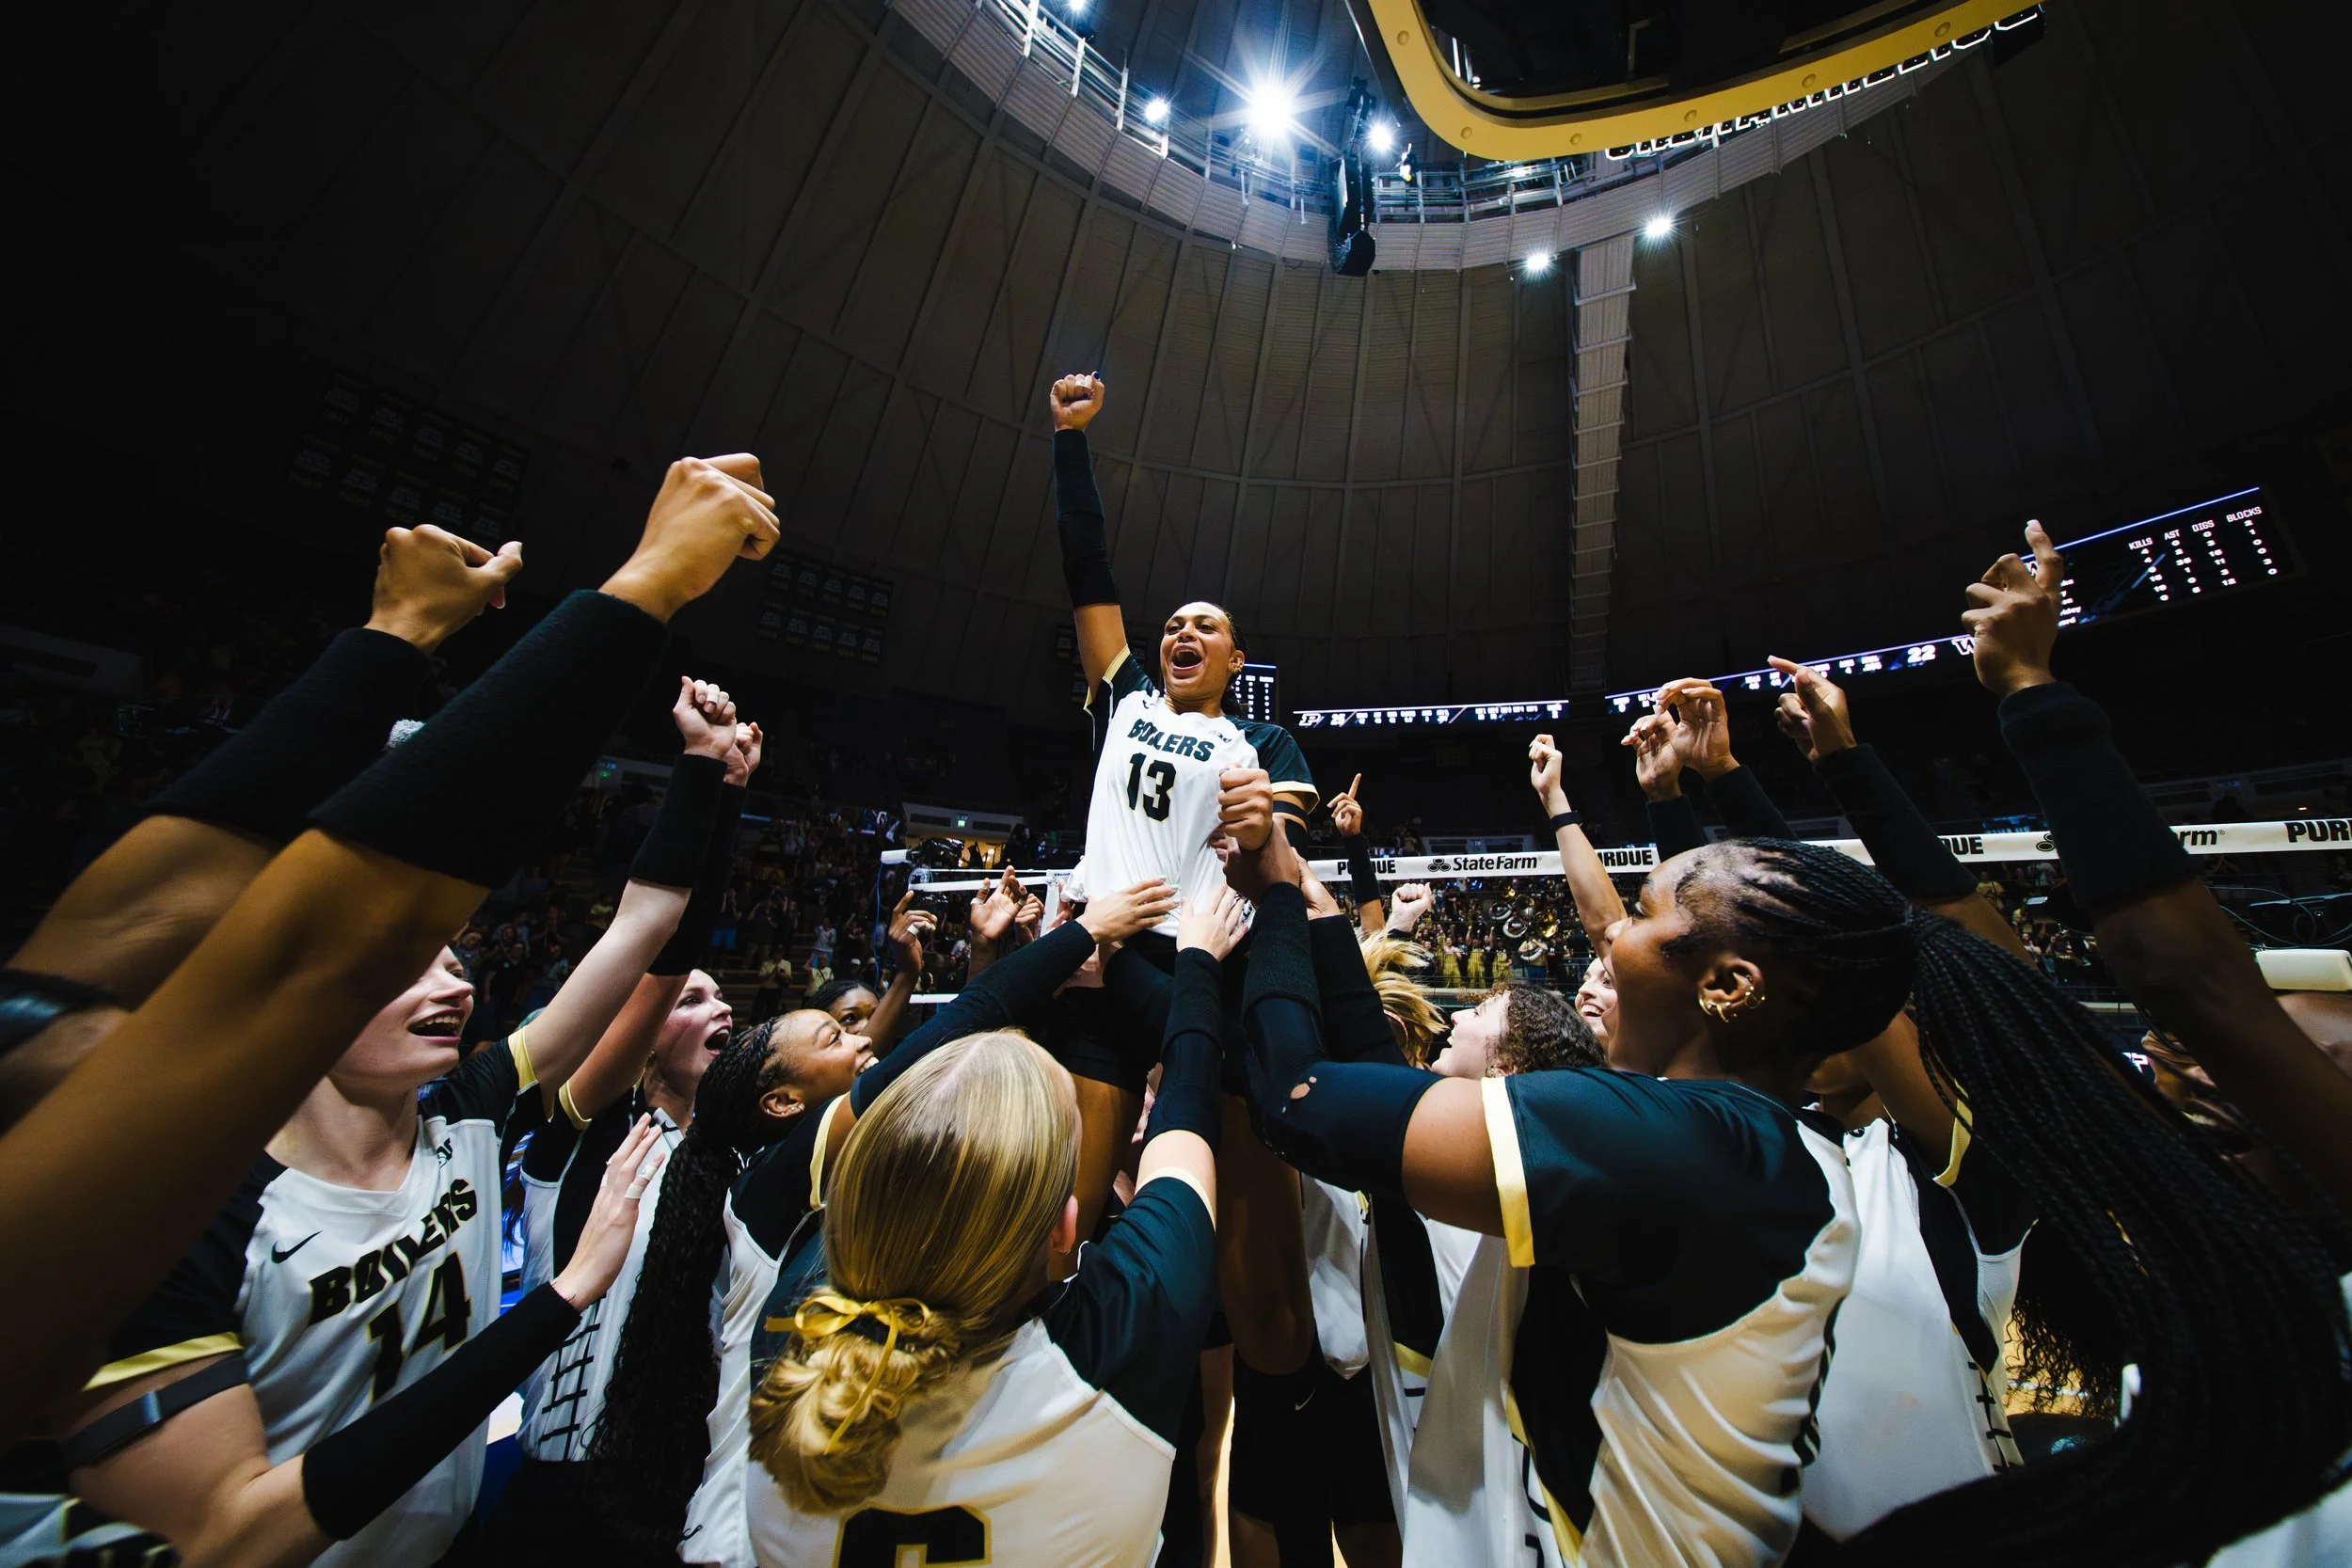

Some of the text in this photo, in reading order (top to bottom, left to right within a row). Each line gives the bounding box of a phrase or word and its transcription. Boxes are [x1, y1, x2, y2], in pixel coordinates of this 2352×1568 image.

[2129, 506, 2262, 549] KILLS AST DIGS BLOCKS
[1907, 644, 1936, 663] 22
[1126, 752, 1177, 823] 13
[2283, 818, 2352, 844] PUR
[1597, 849, 1654, 867] RDUE
[365, 1248, 472, 1406] 14
